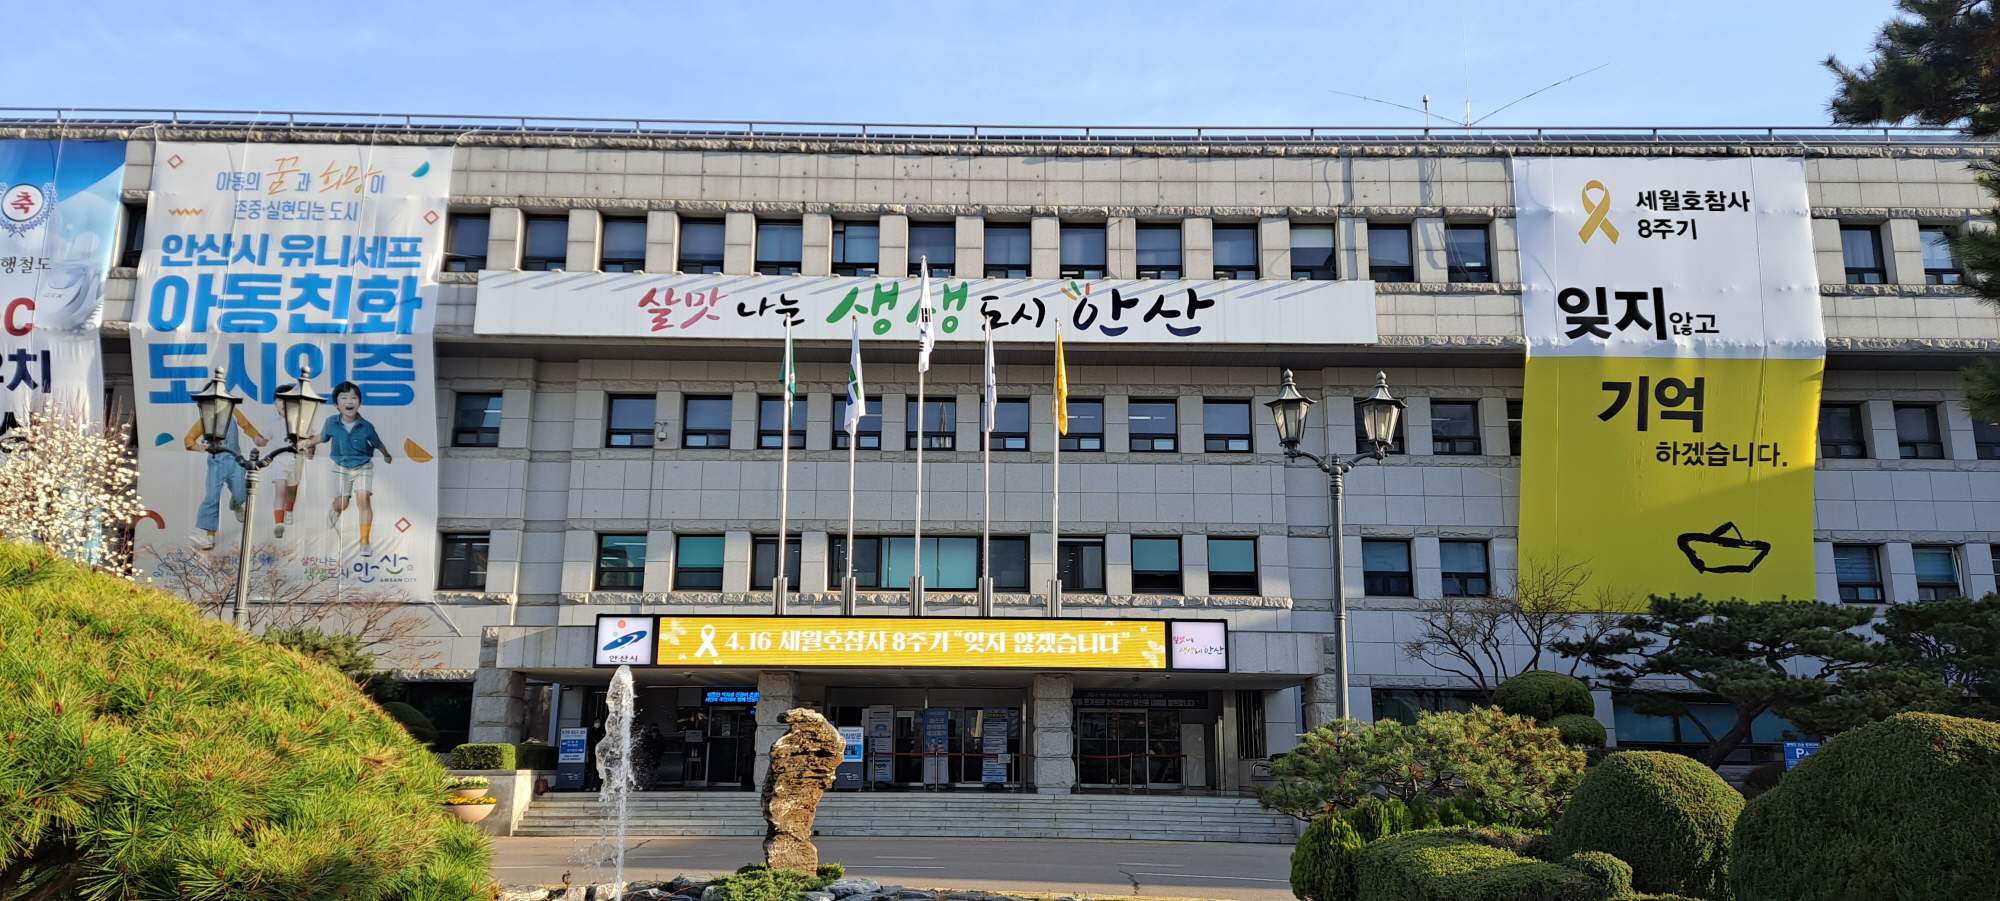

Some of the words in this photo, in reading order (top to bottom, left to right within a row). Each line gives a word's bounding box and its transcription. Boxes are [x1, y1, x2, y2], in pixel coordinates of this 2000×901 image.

[216, 171, 260, 192] 아동의
[10, 191, 35, 214] 축
[233, 200, 325, 221] 존중·실현되는
[329, 202, 358, 222] 도시
[1635, 189, 1751, 213] 세월호참사
[1637, 218, 1698, 240] 8주기
[160, 233, 269, 268] 안산시
[278, 234, 423, 269] 유니세프
[147, 272, 423, 335] 아동친화
[638, 287, 729, 333] 살맛
[737, 293, 806, 328] 나는
[980, 296, 1046, 332] 도시
[1065, 284, 1216, 337] 안산
[1557, 286, 1668, 341] 잊지
[1668, 312, 1720, 337] 않고
[0, 348, 51, 393] 치
[148, 342, 416, 406] 도시인증
[1597, 375, 1706, 433] 기억
[1655, 441, 1788, 468] 하겠습니다.
[353, 553, 408, 583] 안산
[724, 630, 772, 651] 4.16
[778, 630, 887, 653] 세월호참사
[892, 631, 949, 653] 8주기
[609, 654, 639, 663] 안산시
[1796, 748, 1805, 759] P
